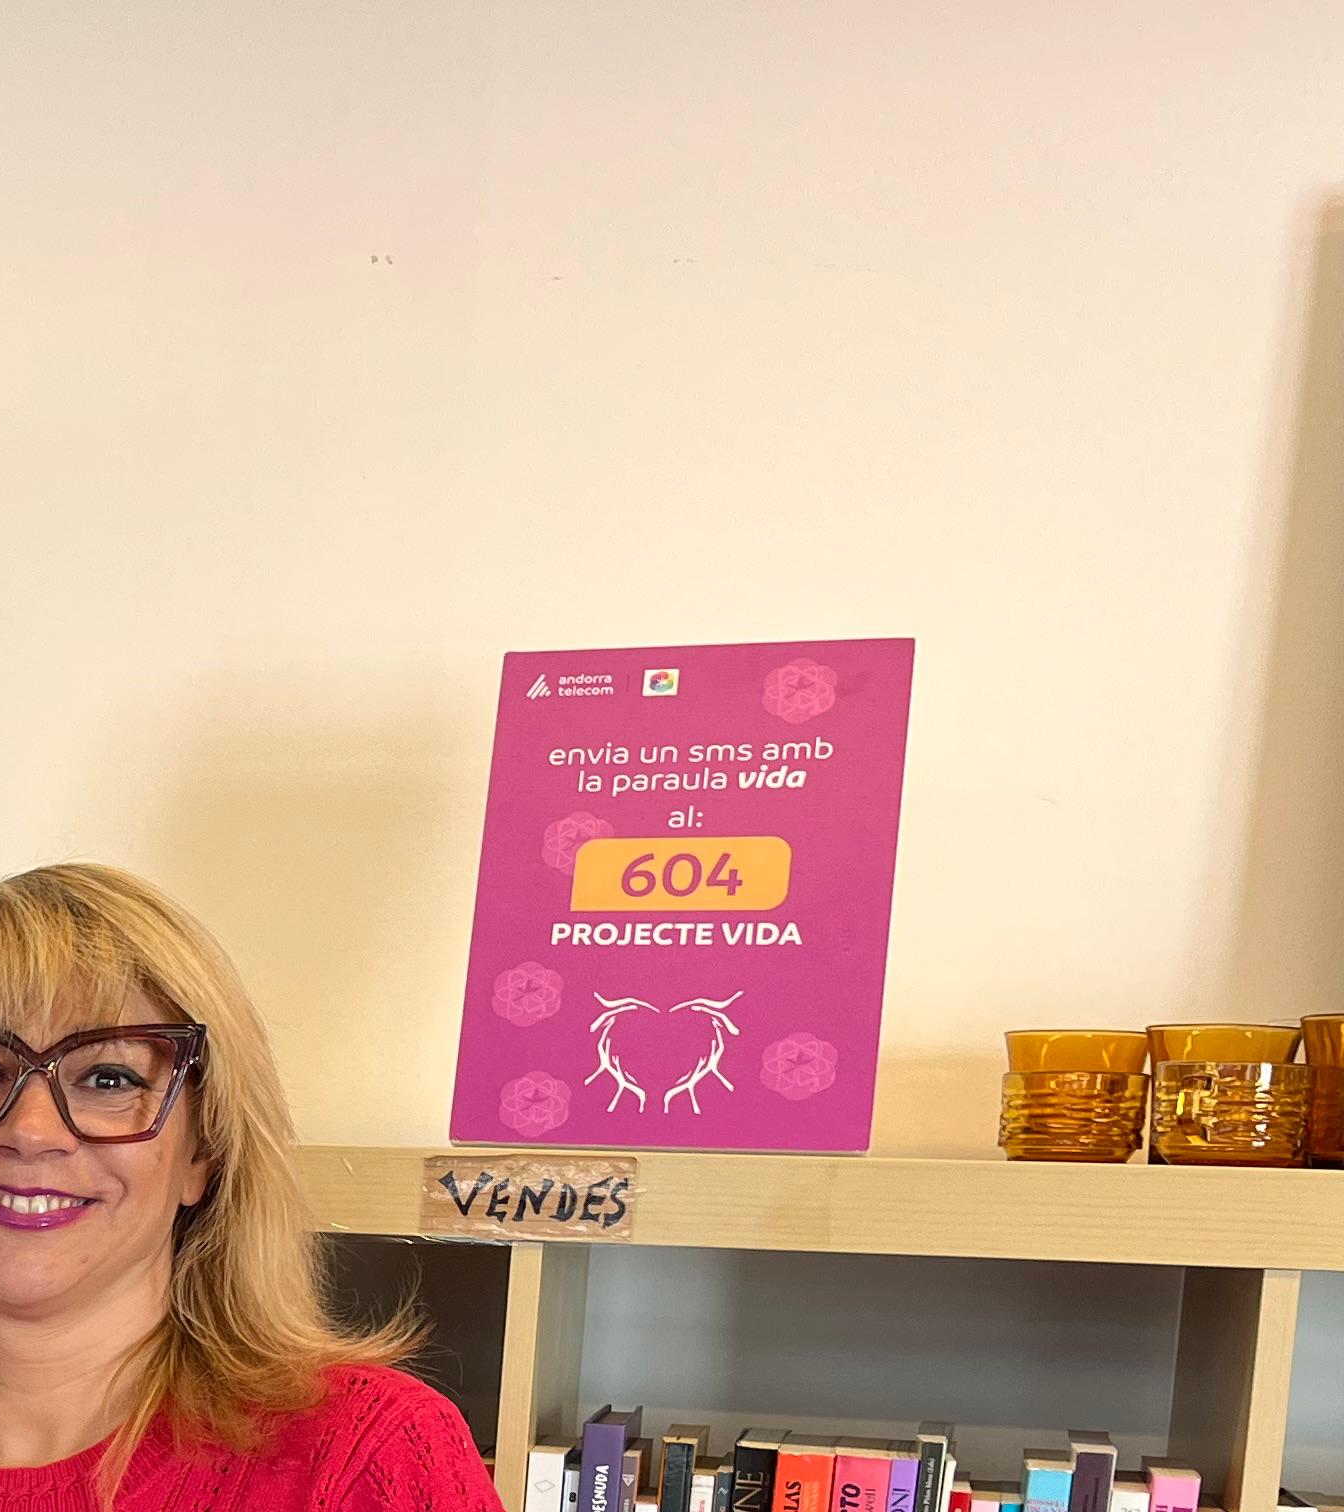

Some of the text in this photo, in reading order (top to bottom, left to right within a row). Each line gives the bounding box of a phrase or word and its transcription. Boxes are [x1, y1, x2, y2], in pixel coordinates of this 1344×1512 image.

[557, 685, 614, 697] telecom
[558, 673, 613, 685] andorra
[548, 737, 834, 766] envia un sms amb
[577, 765, 808, 797] la paraula vida
[667, 806, 703, 829] al:
[620, 853, 743, 898] 604
[550, 921, 803, 948] PROJECTE VIDA
[437, 1168, 631, 1228] VENDES
